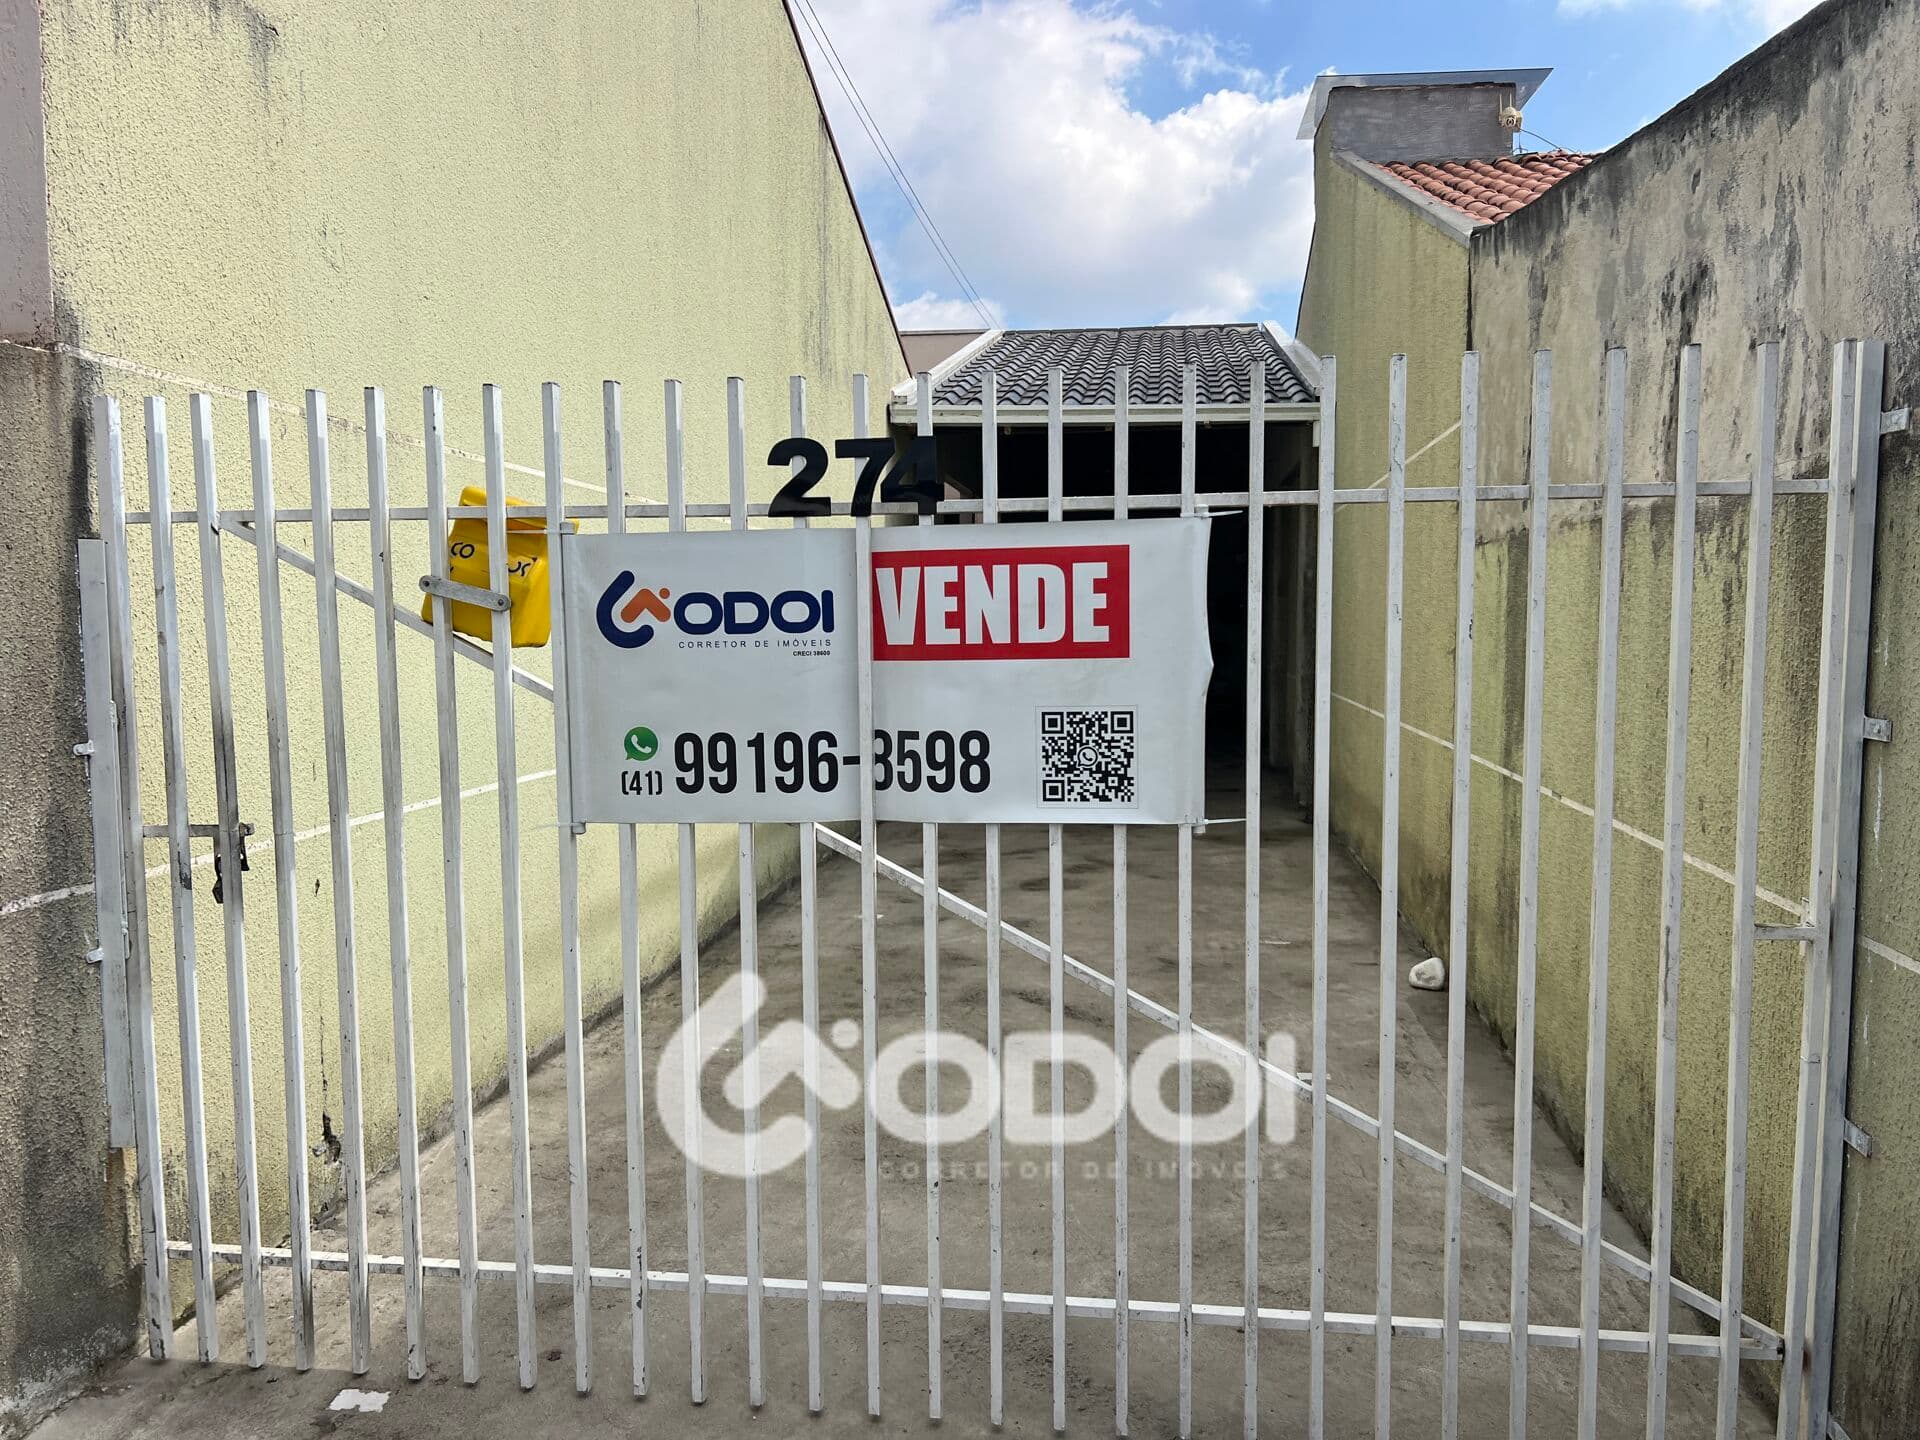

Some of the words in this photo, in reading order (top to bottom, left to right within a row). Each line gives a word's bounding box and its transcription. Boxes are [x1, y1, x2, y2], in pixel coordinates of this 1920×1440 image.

[767, 436, 945, 518] 274
[875, 561, 1110, 646] VENDE
[678, 640, 747, 649] CORRETOR
[754, 640, 769, 648] DE
[777, 638, 832, 648] IMÓVEIS
[621, 770, 663, 796] (41)
